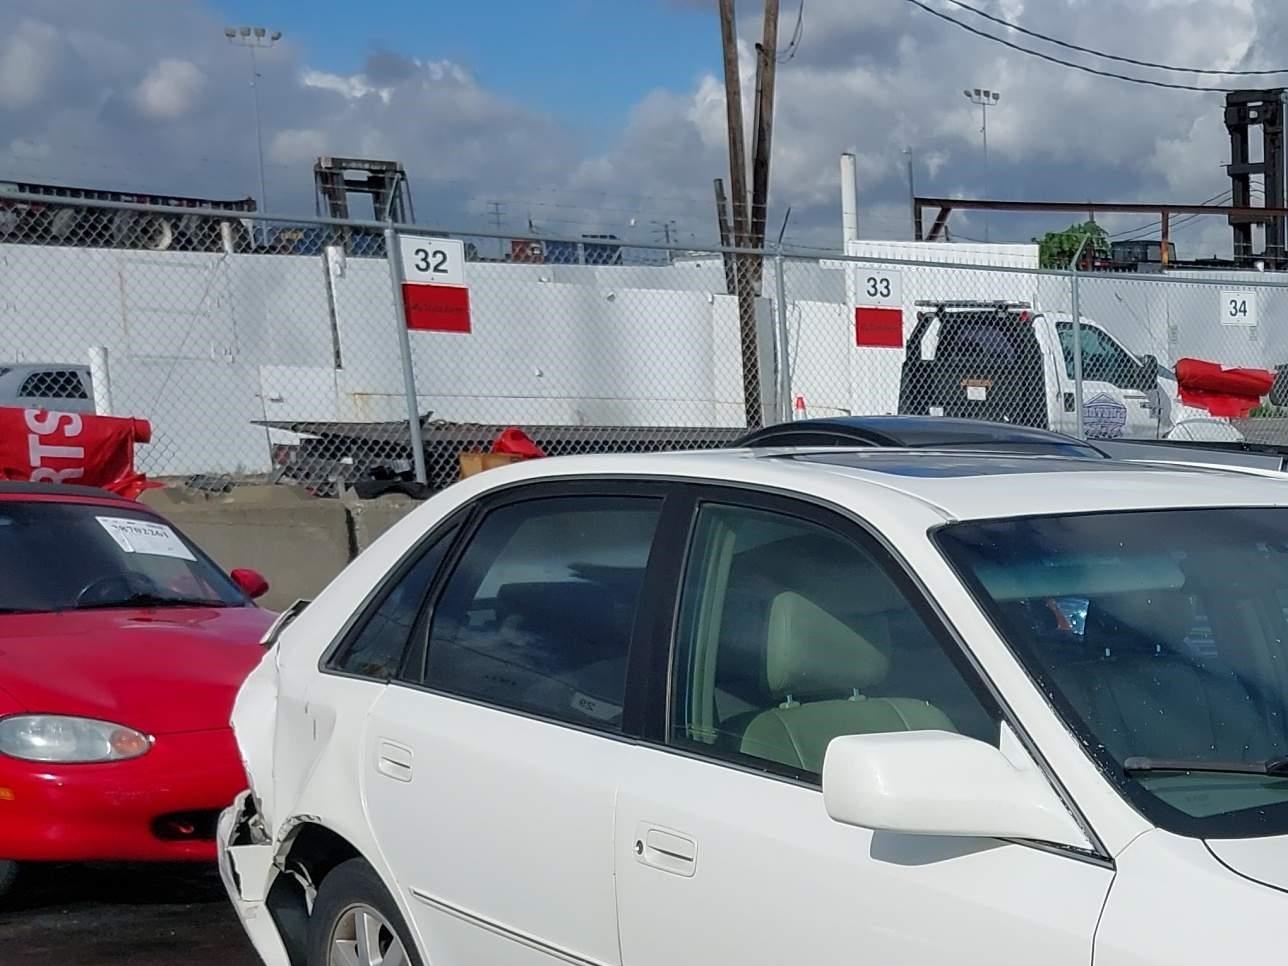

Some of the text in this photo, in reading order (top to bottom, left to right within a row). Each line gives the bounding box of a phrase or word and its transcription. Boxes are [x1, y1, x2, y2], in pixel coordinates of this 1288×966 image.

[414, 248, 449, 274] 32
[866, 276, 891, 298] 33
[1229, 299, 1248, 317] 34
